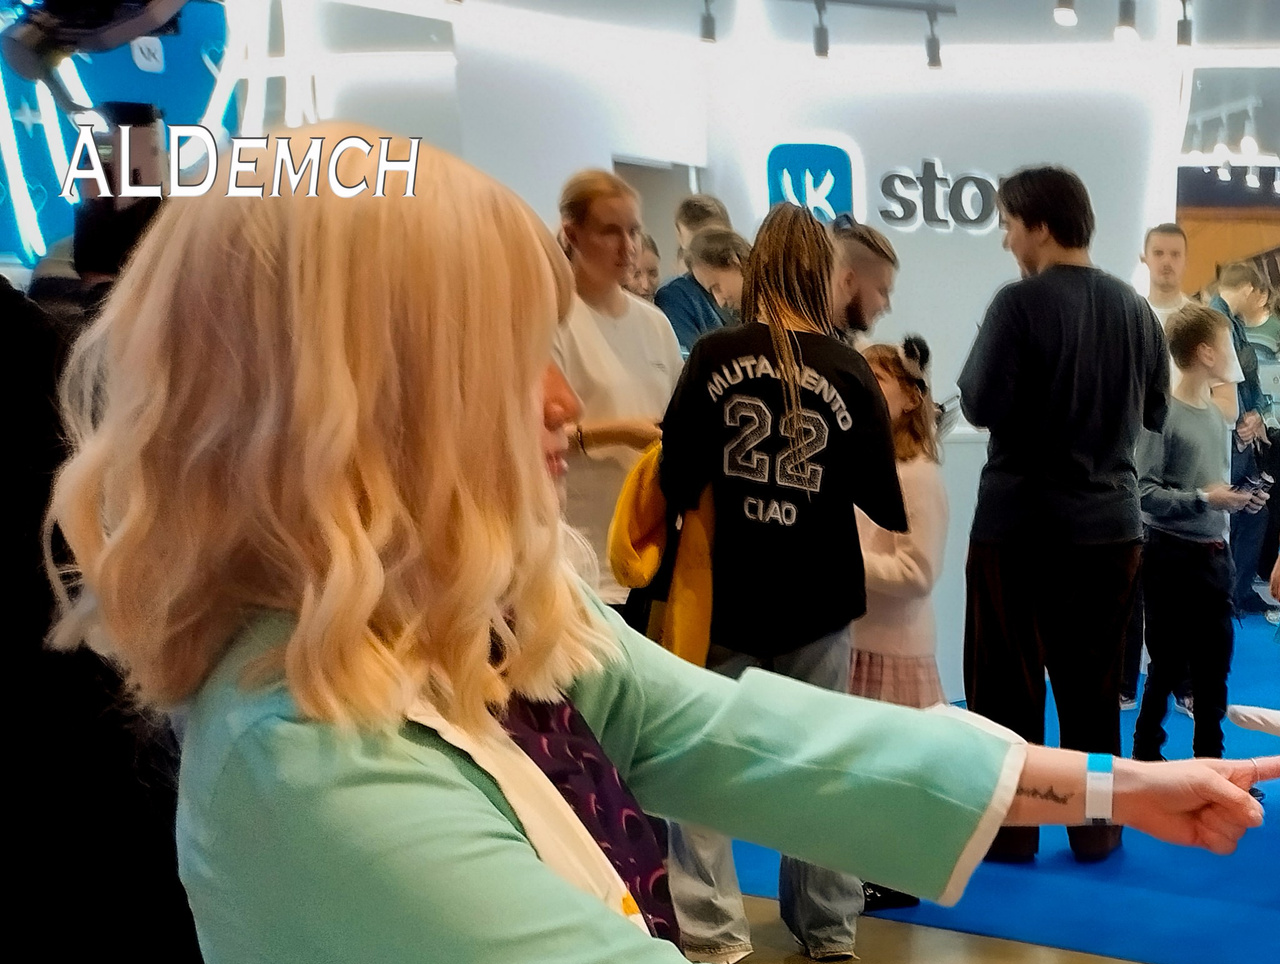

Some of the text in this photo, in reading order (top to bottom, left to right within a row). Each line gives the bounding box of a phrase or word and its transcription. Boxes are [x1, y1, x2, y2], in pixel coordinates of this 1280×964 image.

[879, 158, 1006, 228] sto
[707, 355, 854, 432] MUTAENTO
[723, 394, 830, 493] 22
[743, 496, 799, 527] CIAO
